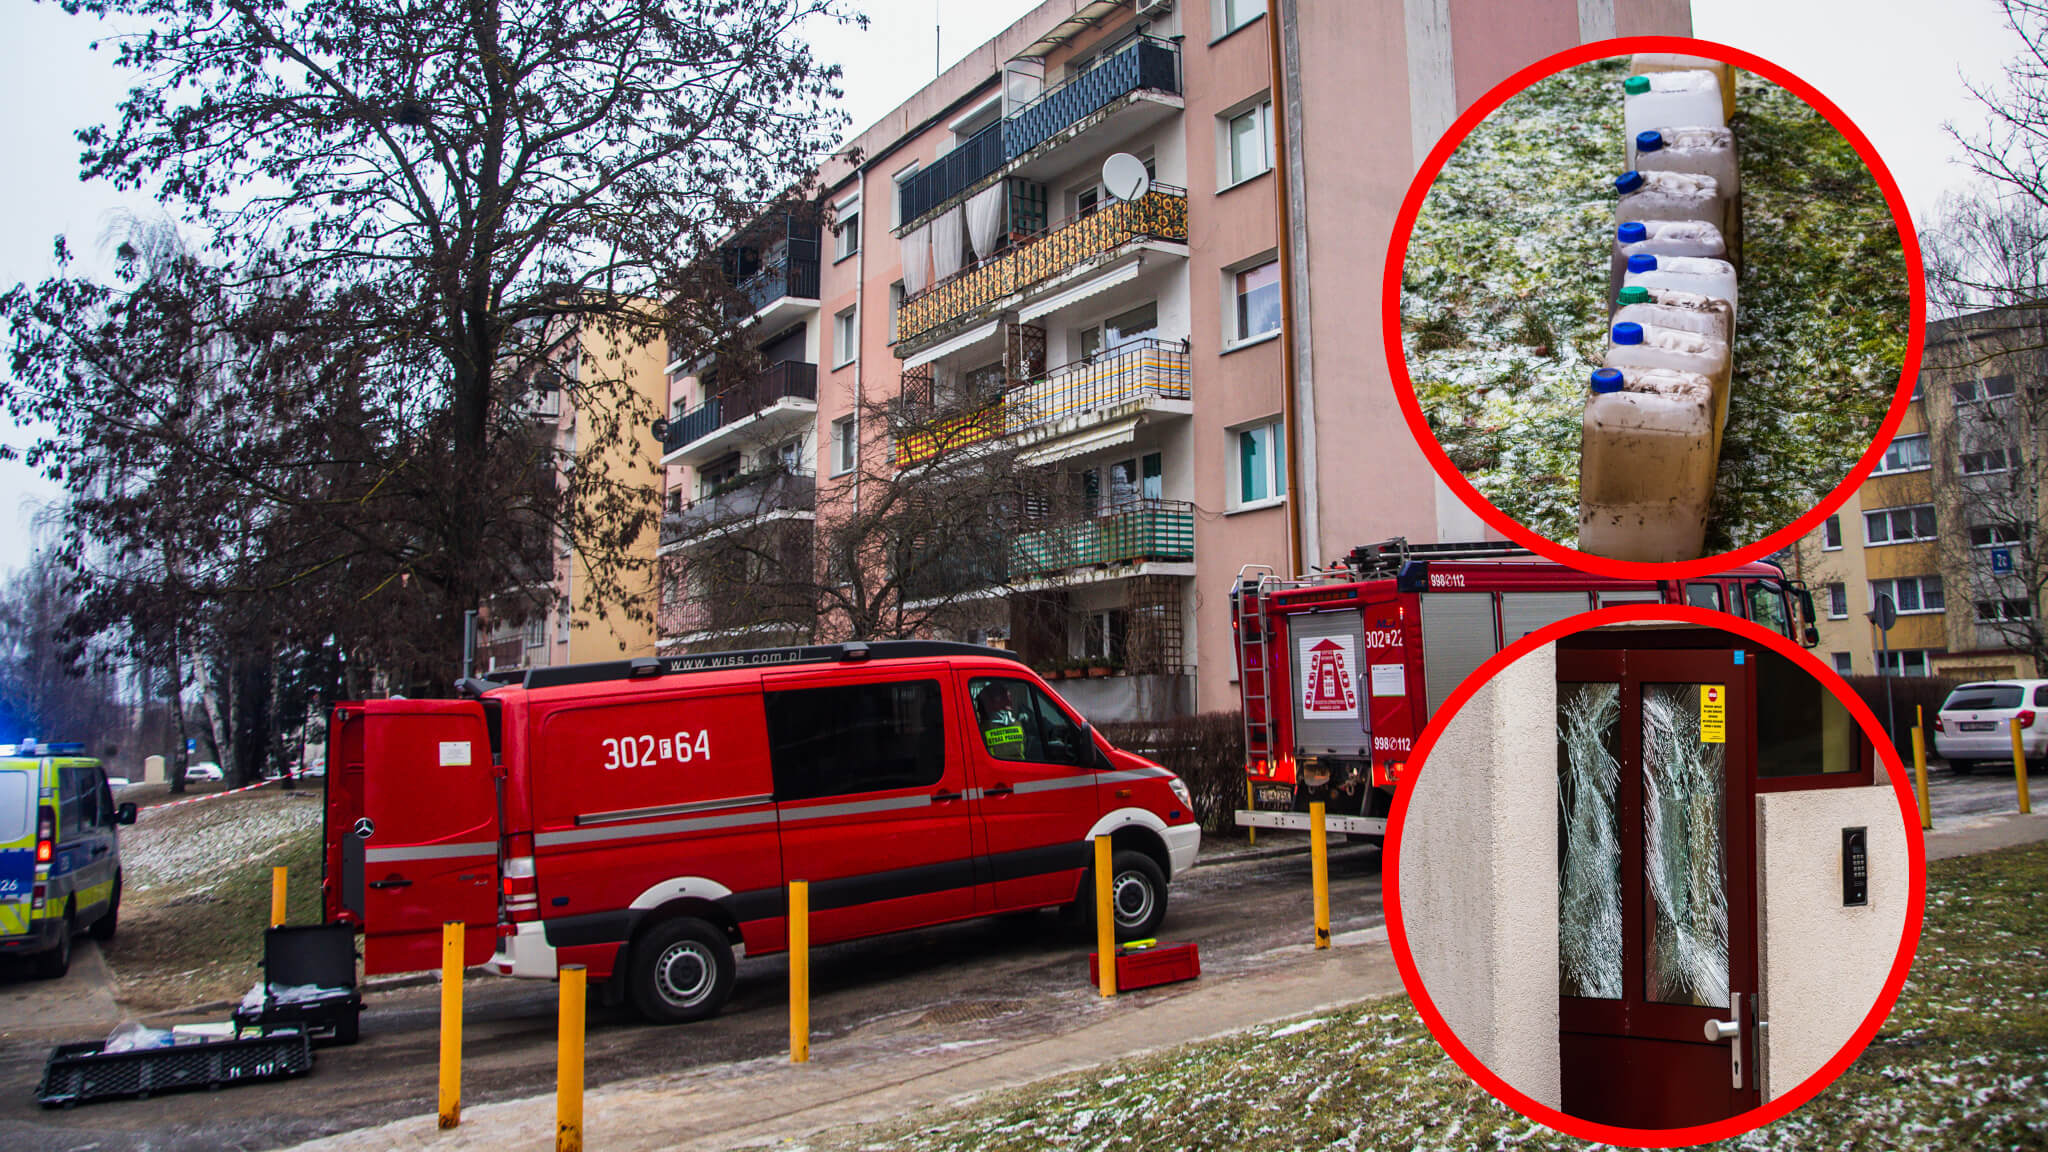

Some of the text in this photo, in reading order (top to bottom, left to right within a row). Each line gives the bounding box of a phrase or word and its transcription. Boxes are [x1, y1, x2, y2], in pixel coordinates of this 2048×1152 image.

[1431, 574, 1445, 587] 998
[1453, 574, 1465, 587] 112
[1374, 736, 1411, 752] 998 112
